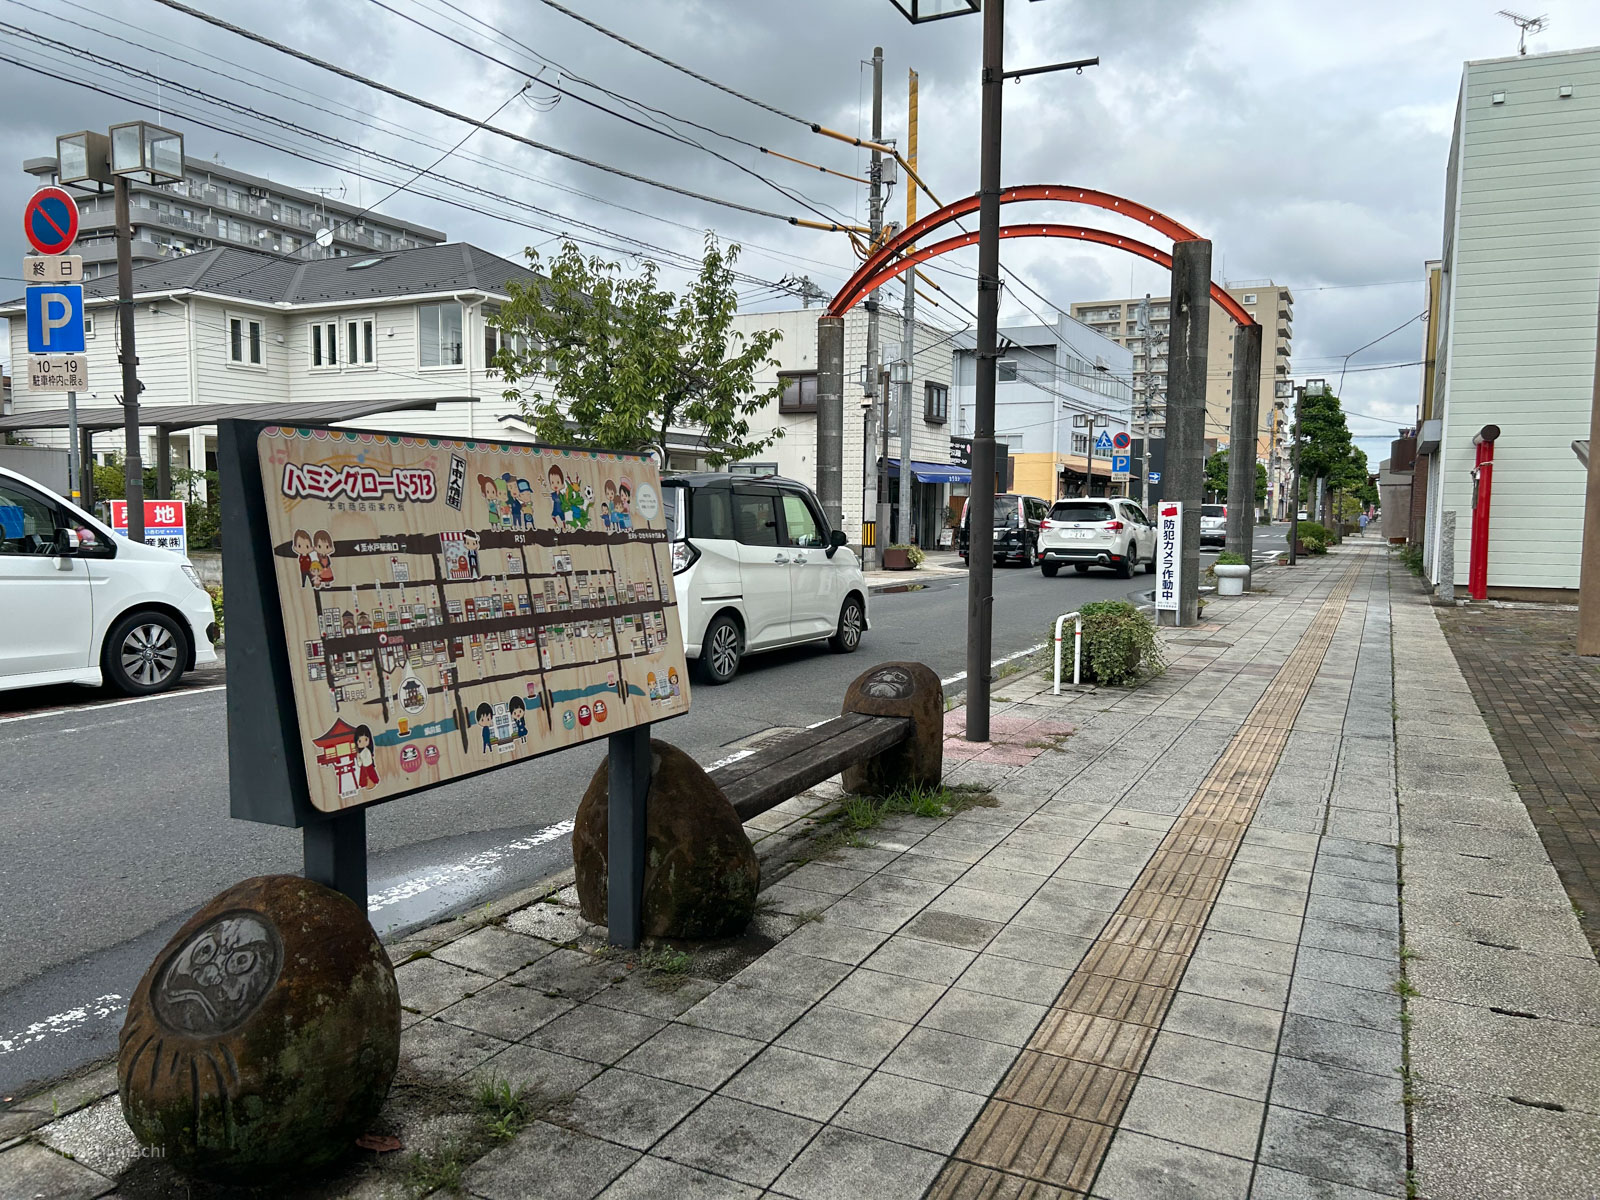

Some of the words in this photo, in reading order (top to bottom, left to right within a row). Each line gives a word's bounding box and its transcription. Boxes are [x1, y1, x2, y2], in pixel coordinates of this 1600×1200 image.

[33, 261, 72, 276] 終日
[41, 292, 73, 346] P
[32, 374, 83, 387] 駐車枠内に限る
[1116, 457, 1127, 471] P
[285, 465, 434, 499] ハミングロード513
[447, 457, 464, 508] 下市人情街
[514, 534, 526, 543] R51
[1162, 519, 1175, 601] 防犯カメラ作動中
